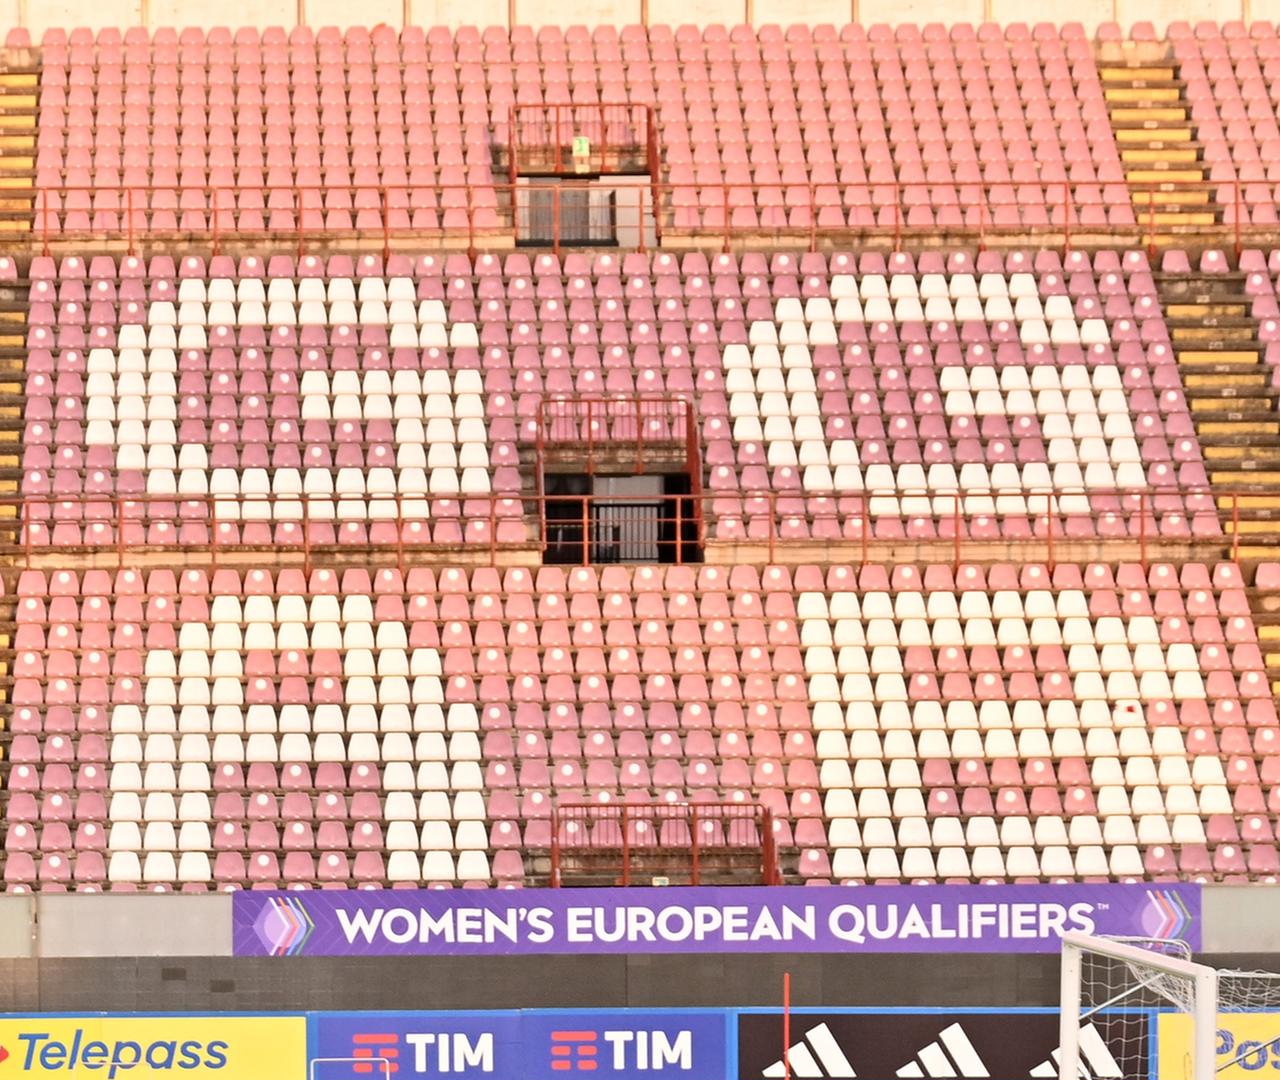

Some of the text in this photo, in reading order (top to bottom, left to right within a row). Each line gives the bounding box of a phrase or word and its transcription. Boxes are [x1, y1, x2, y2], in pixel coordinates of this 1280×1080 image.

[335, 907, 554, 944] WOMEN'S
[567, 905, 816, 942] EUROPEAN
[18, 1029, 229, 1079] Telepass
[406, 1033, 494, 1073] TIM
[605, 1030, 692, 1070] TIM
